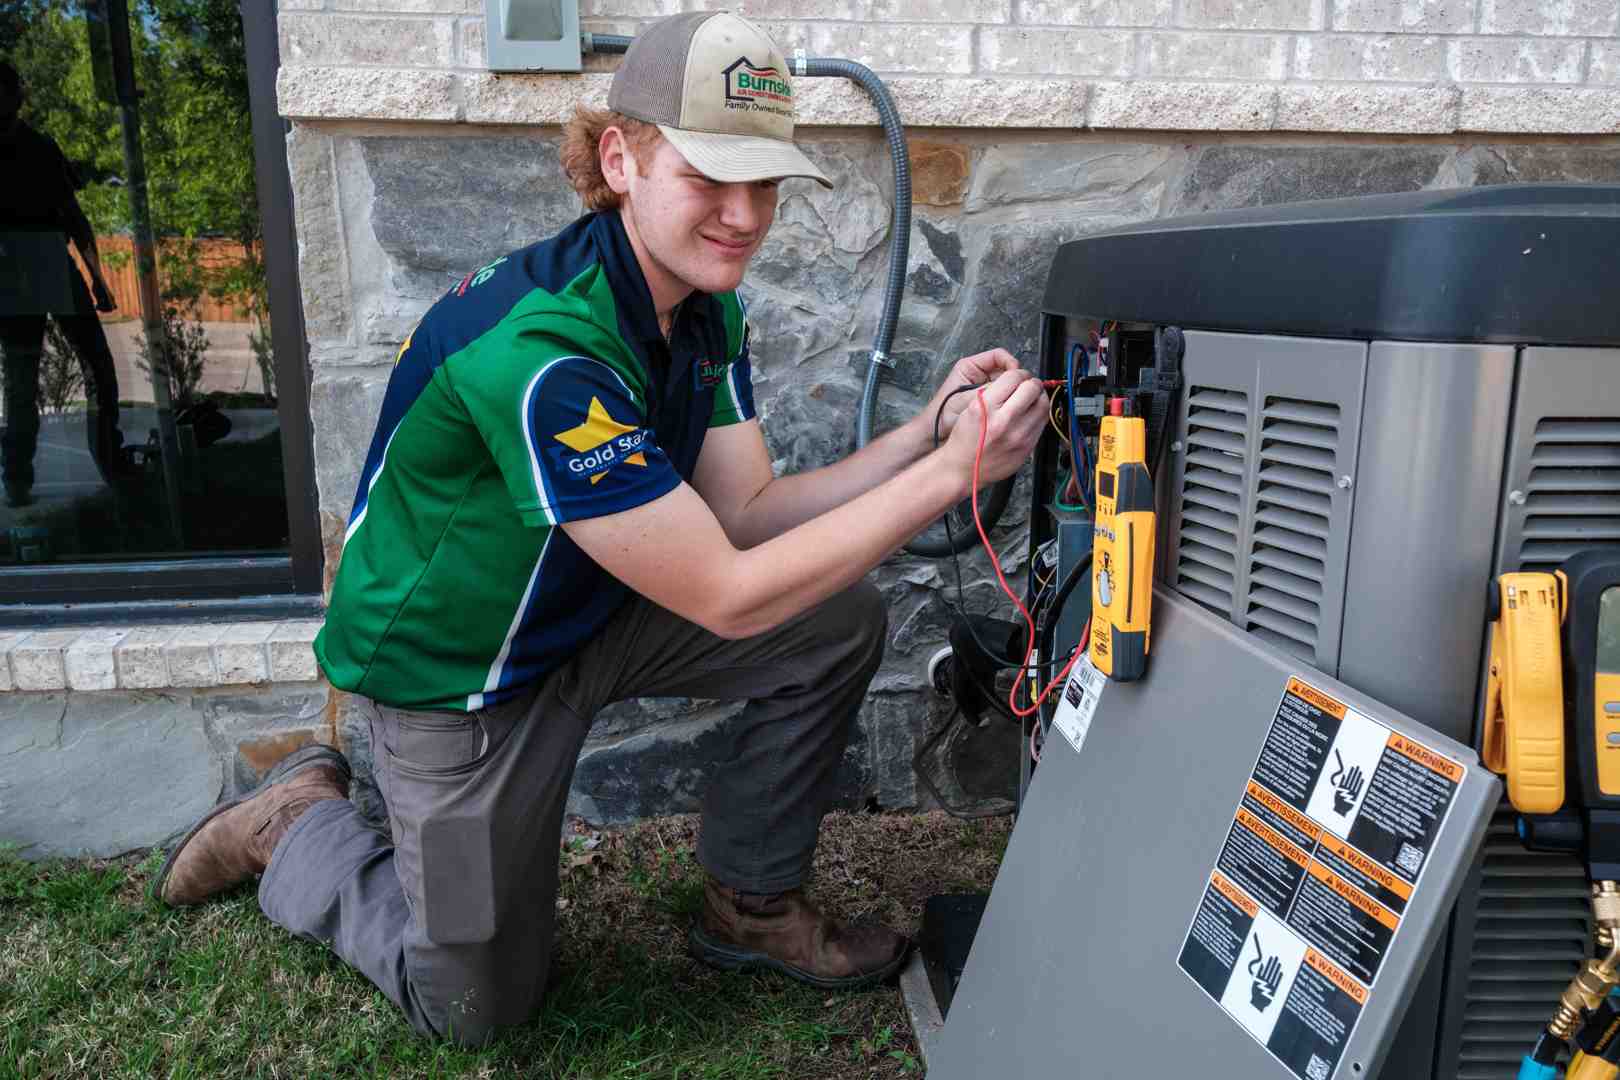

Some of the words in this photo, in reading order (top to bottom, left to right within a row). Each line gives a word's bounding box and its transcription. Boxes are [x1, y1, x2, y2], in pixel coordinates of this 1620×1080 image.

[724, 99, 751, 112] Family
[568, 444, 615, 472] Gold
[618, 429, 648, 452] Star
[1406, 742, 1455, 776] WARNING
[1257, 788, 1320, 837] AVERTISSEMENT
[1245, 815, 1309, 866] AVERTISSEMENT
[1347, 849, 1394, 888] WARNING
[1334, 877, 1382, 918] WARNING
[1318, 958, 1363, 998] WARNING
